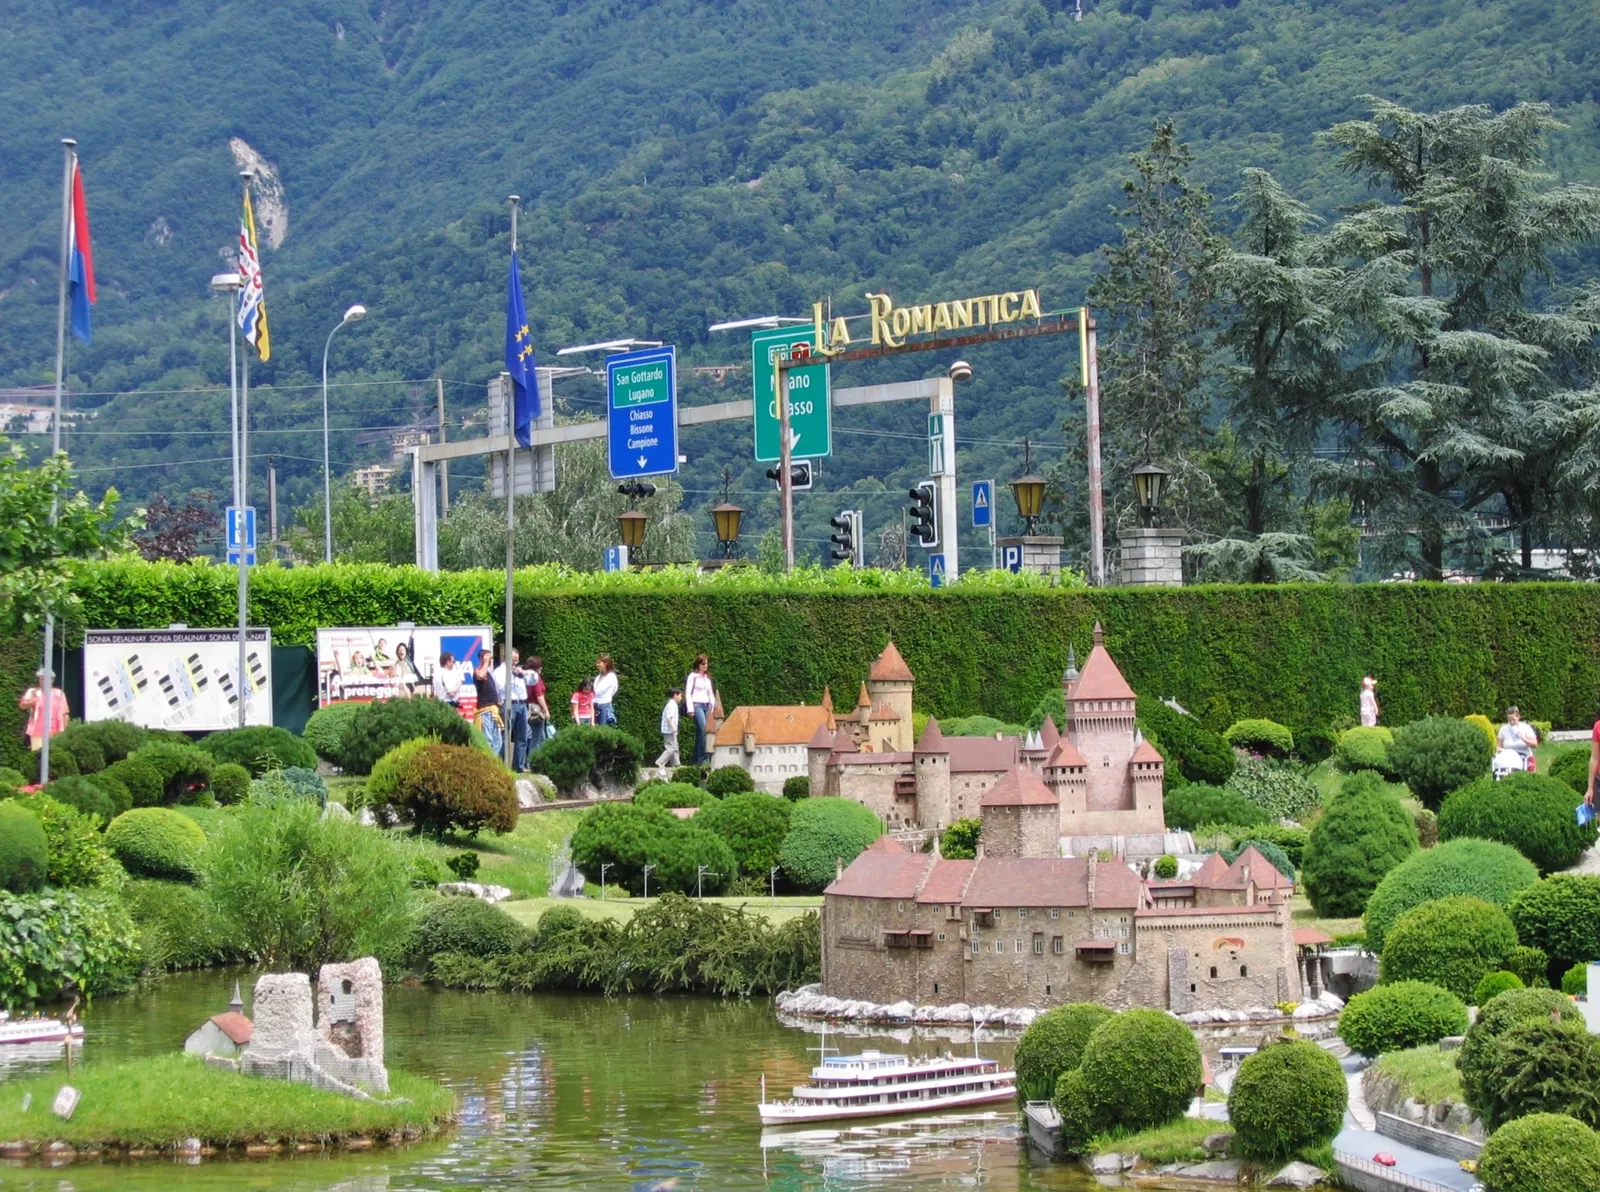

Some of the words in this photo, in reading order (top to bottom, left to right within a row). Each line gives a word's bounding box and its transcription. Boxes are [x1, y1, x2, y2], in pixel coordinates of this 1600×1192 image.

[616, 373, 630, 386] San
[631, 367, 663, 384] Gottardo
[628, 388, 655, 404] Lugano
[630, 409, 654, 421] Chiasso
[769, 400, 814, 418] Casso
[630, 423, 654, 435] Bissone
[627, 436, 658, 450] Campione
[609, 549, 615, 564] P
[1006, 546, 1018, 569] P
[88, 635, 111, 644] SONIA
[112, 635, 147, 643] DELAUNAY
[149, 634, 172, 643] SONIA
[173, 634, 207, 642] DELAUNAY
[209, 634, 231, 642] SONIA
[344, 685, 400, 699] protegge
